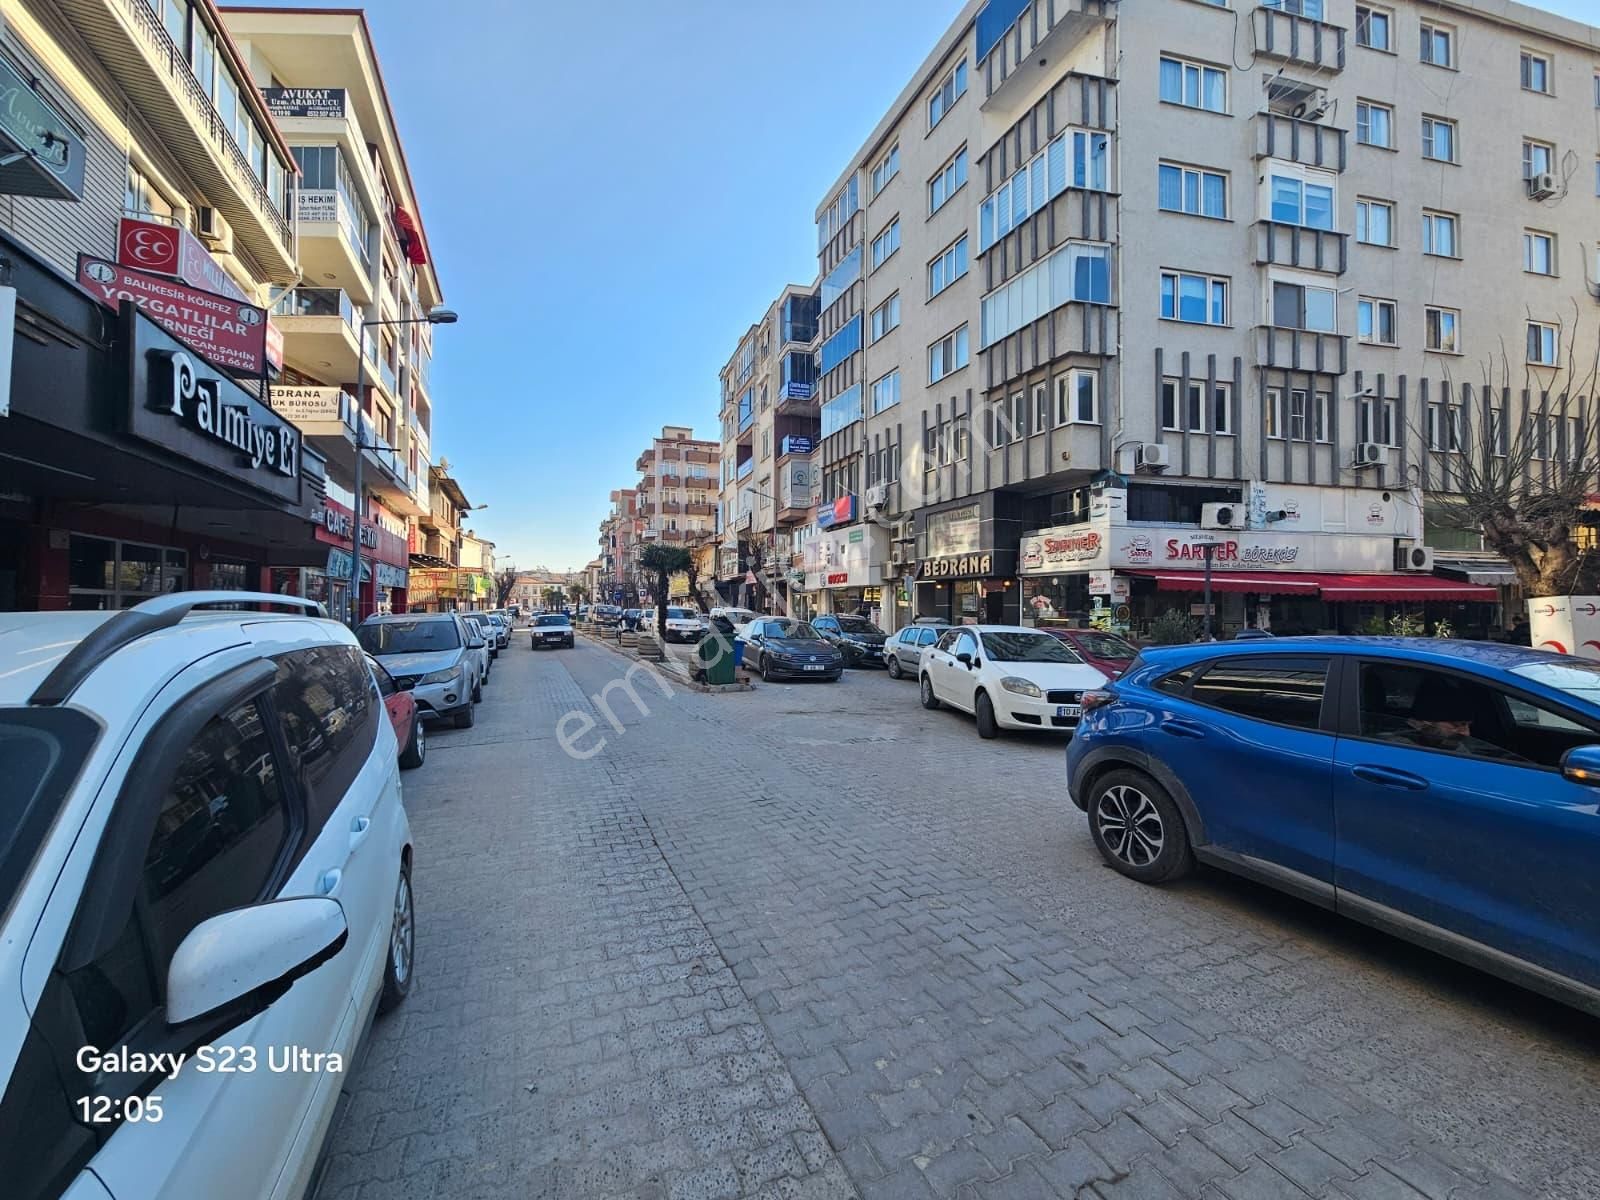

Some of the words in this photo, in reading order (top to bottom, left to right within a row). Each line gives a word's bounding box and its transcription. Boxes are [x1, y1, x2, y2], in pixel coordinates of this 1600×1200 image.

[281, 89, 331, 99] AVUKAT
[290, 98, 340, 106] ARABULUCU
[123, 276, 185, 301] BALIKESİR
[187, 293, 232, 315] KÖRFEZ
[101, 285, 248, 337] YOZGATLILAR
[154, 315, 214, 341] RNEĞİ
[207, 352, 226, 364] 101
[228, 356, 241, 366] 66
[242, 359, 255, 370] 66
[219, 345, 256, 362] ŞAHİN
[270, 389, 321, 399] EDRANA
[171, 351, 274, 469] Palmiye
[923, 554, 991, 577] BEDRANA
[827, 573, 848, 584] BOSCH
